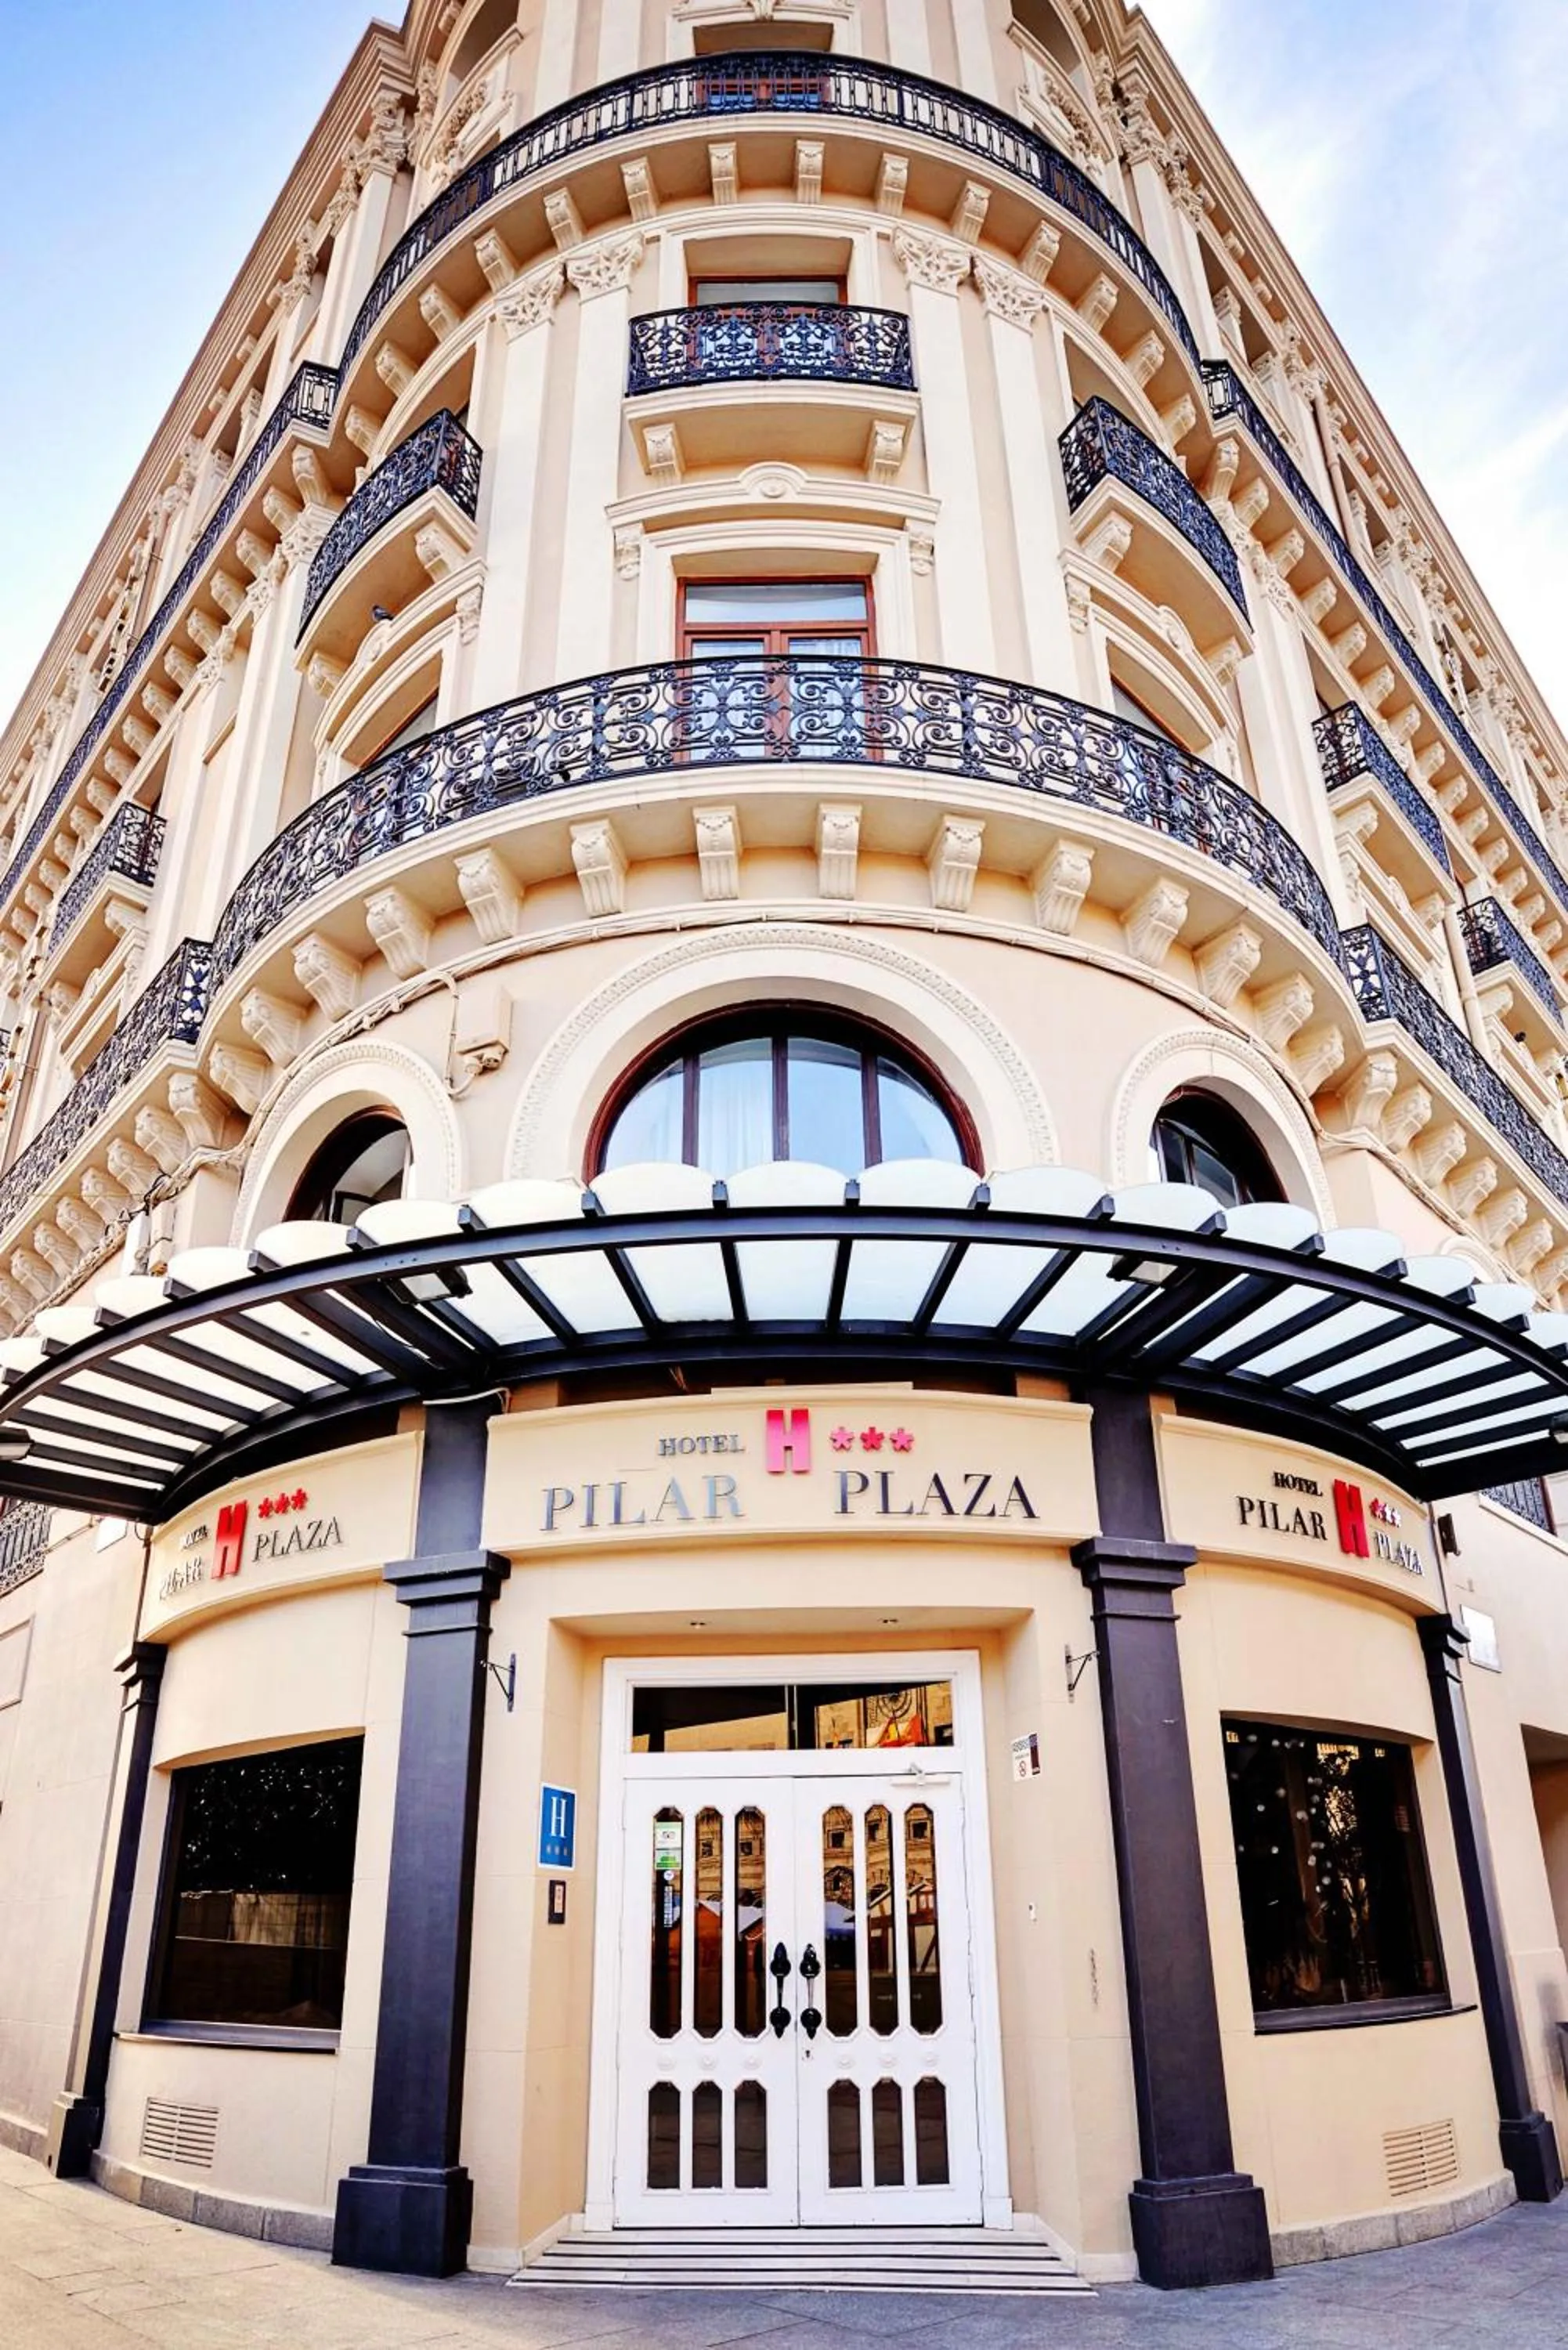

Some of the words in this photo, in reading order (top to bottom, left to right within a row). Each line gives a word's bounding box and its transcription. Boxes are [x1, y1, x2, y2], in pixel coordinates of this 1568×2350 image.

[659, 1433, 745, 1457] HOTEL
[765, 1408, 811, 1474] H
[540, 1473, 746, 1531] PILAR
[833, 1470, 1040, 1520] PLAZA
[1272, 1471, 1324, 1497] HOTEL
[252, 1516, 343, 1564] PLAZA
[1236, 1495, 1328, 1542] PILAR
[551, 1795, 568, 1839] H
